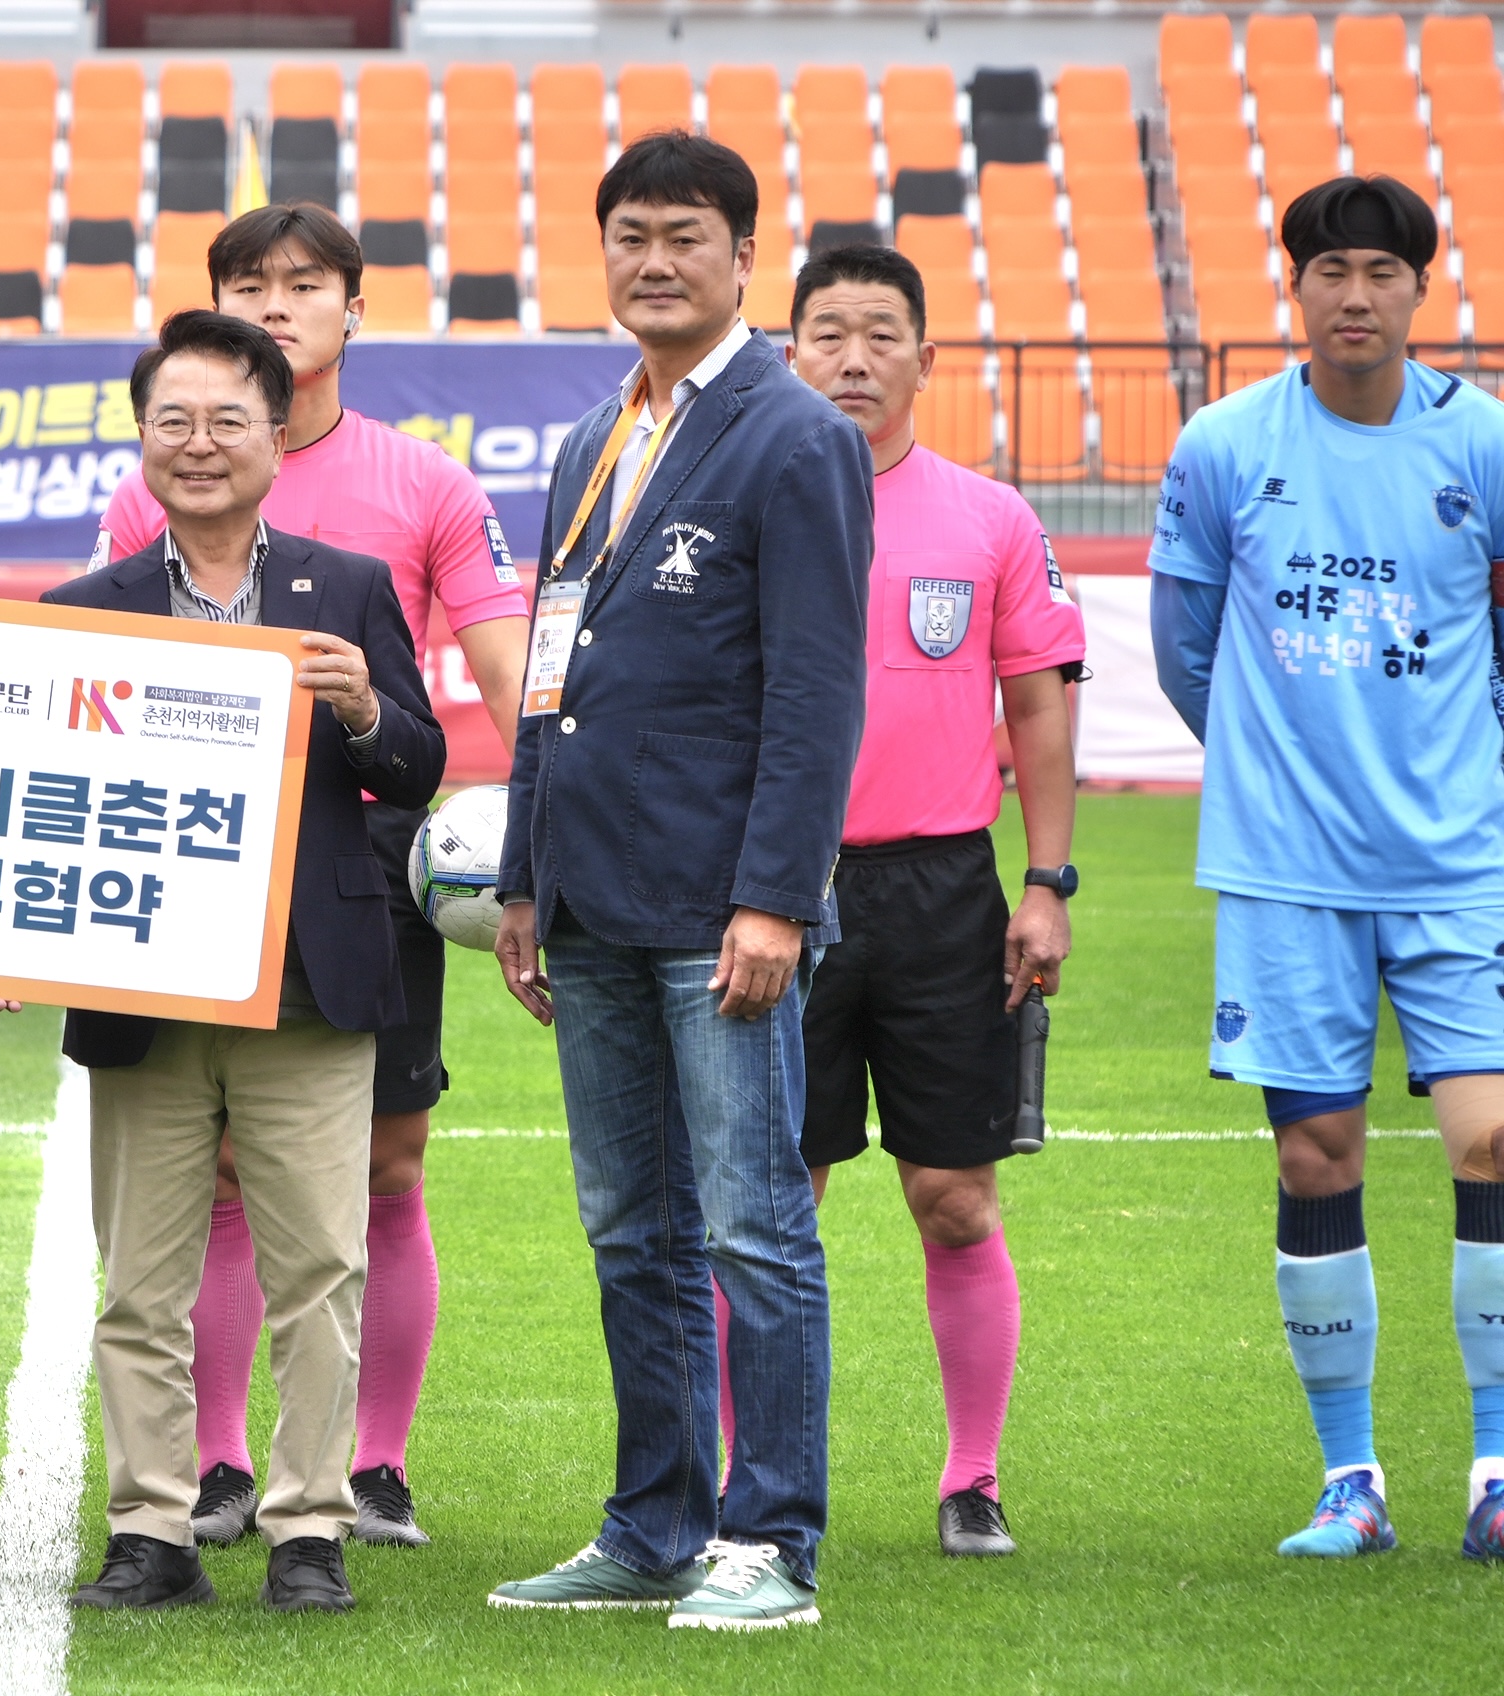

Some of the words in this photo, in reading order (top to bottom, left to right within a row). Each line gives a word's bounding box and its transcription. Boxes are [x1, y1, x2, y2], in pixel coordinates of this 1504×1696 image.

[674, 523, 693, 532] RALPH
[666, 544, 674, 552] 19
[690, 547, 699, 555] 67
[1321, 553, 1396, 583] 2025
[660, 573, 693, 586] R.L.Y.C.
[912, 580, 971, 595] REFEREE
[929, 646, 944, 654] KFA
[1272, 627, 1372, 676] 원년의
[1382, 644, 1426, 679] 해
[149, 687, 204, 704] 사회복지법인
[211, 694, 247, 708] 남강재단
[538, 694, 550, 706] VIP
[4, 706, 30, 716] CLUB
[142, 704, 260, 736] 춘천지역자활센터
